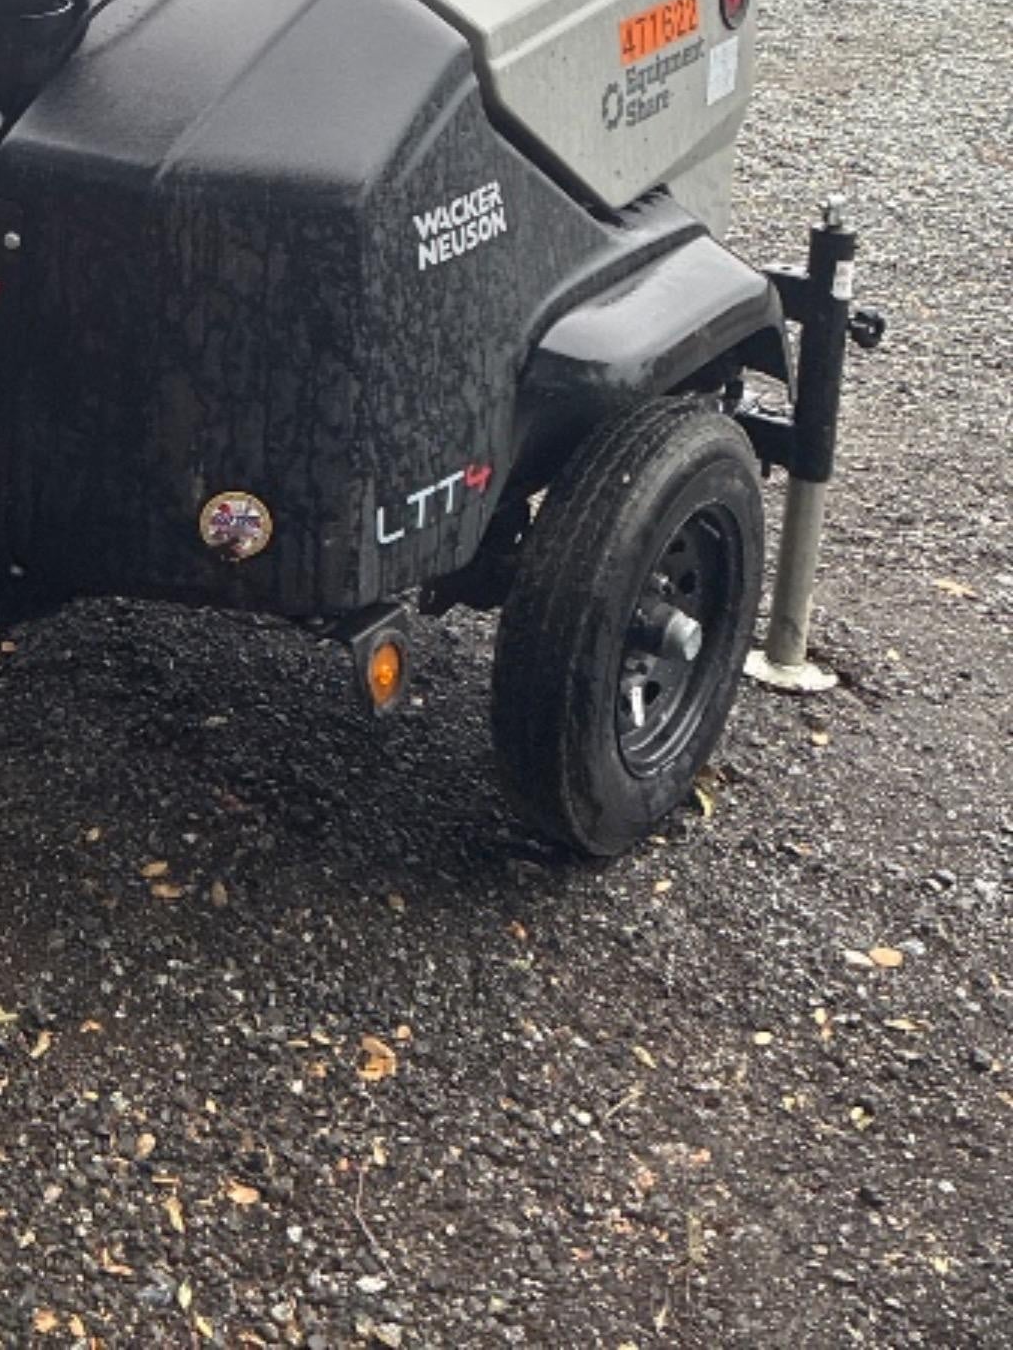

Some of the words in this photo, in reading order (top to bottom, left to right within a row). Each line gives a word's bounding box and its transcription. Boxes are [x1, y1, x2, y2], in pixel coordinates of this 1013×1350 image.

[625, 34, 706, 96] Equipment
[412, 181, 504, 241] WACKER
[417, 206, 508, 272] NEUSON
[376, 463, 491, 545] LTT4
